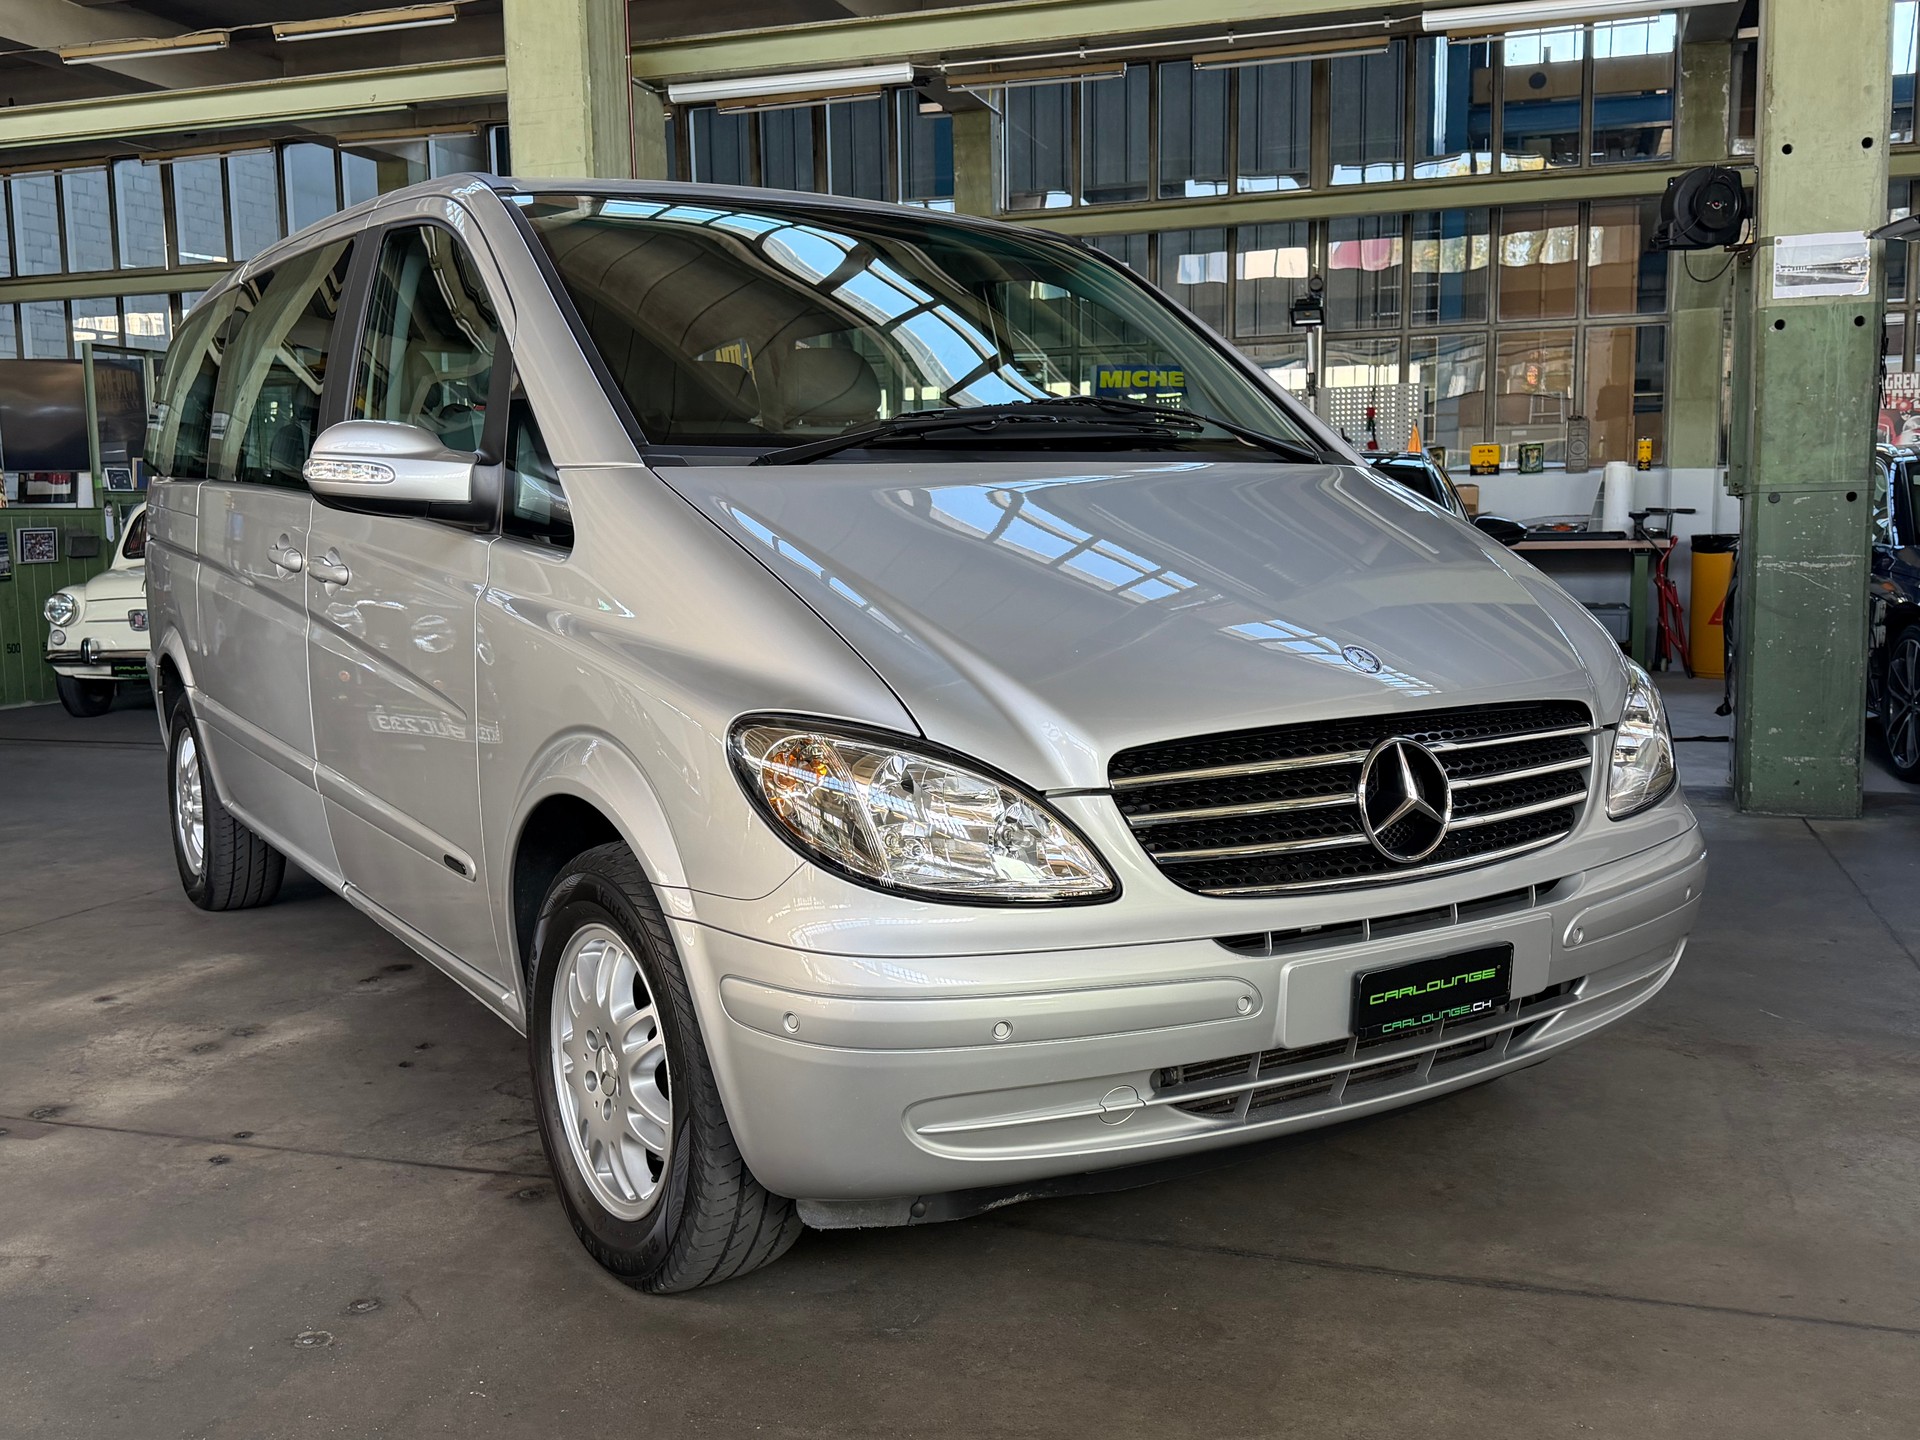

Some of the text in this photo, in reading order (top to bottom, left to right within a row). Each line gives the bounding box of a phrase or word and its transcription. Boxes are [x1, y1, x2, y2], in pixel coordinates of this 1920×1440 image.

[1100, 370, 1184, 388] MICHE
[1369, 967, 1496, 1005] CARLOUNGE
[1382, 999, 1492, 1033] CARLOUNGE.CH
